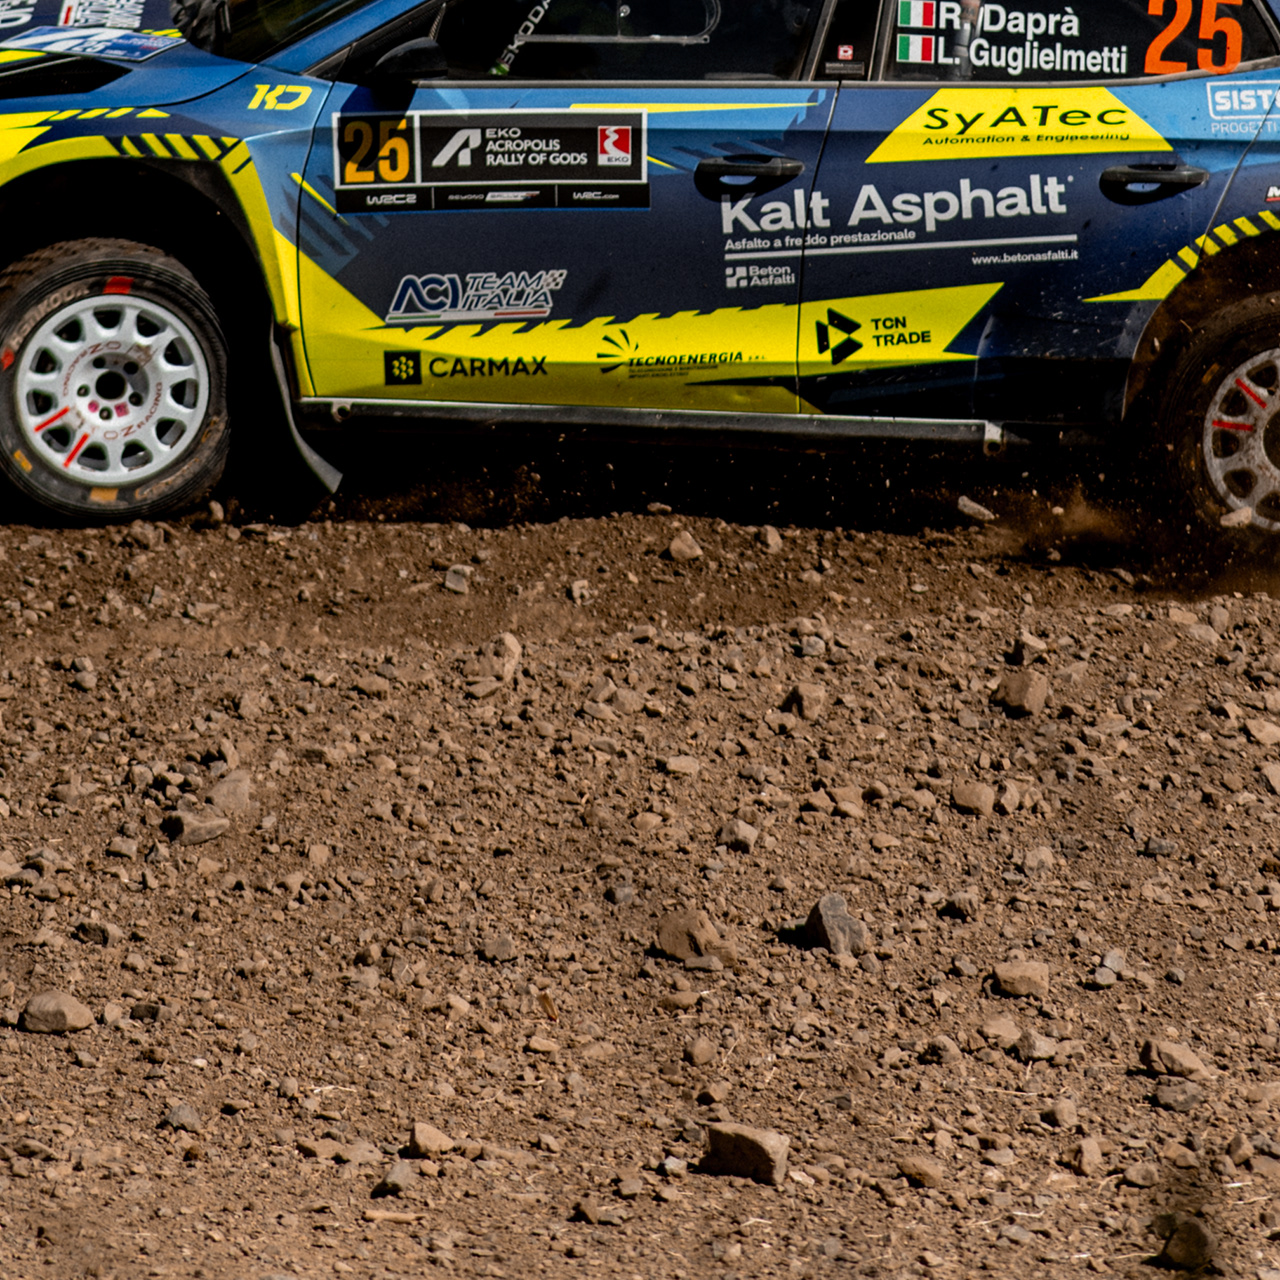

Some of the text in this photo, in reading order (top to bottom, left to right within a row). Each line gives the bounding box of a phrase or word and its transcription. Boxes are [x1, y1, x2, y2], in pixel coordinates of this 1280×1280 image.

[982, 4, 1079, 38] Daprà
[938, 38, 1128, 76] L. Guglielmetti
[486, 128, 521, 138] EKO
[923, 134, 1013, 146] Automation
[1036, 133, 1130, 141] Engineering
[344, 119, 410, 183] 25
[486, 139, 561, 152] ACROPOLIS
[486, 153, 588, 166] RALLY OF GODS
[366, 193, 417, 205] WRC2
[721, 174, 1066, 234] Kalt Asphalt
[724, 228, 917, 251] Asfalto a freddo prestazionale
[971, 249, 1079, 265] www.betonasfalti.it
[749, 266, 791, 276] Beton
[466, 272, 544, 290] TEAM
[749, 273, 795, 287] Asfalti
[462, 289, 553, 309] ITALIA
[871, 317, 907, 330] TCN
[873, 330, 931, 347] TRADE
[429, 355, 548, 378] CARMAX
[629, 351, 743, 367] TECNOENERGIA
